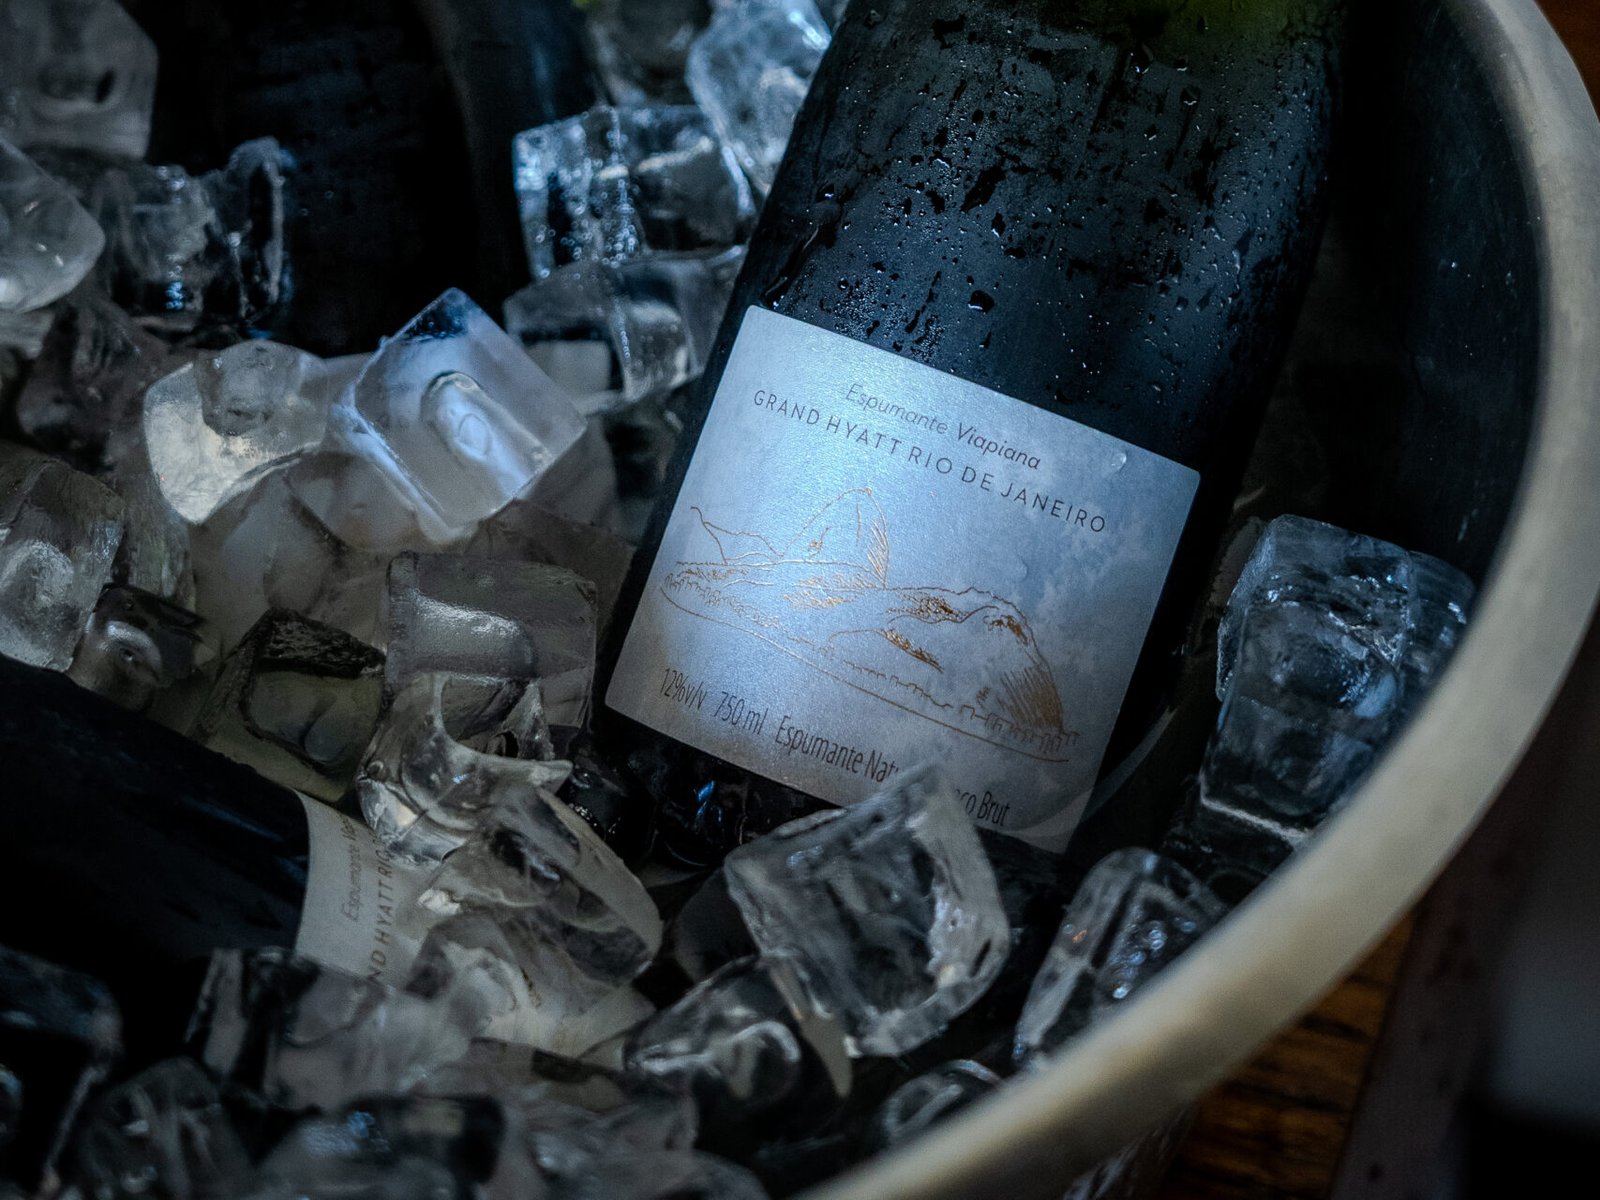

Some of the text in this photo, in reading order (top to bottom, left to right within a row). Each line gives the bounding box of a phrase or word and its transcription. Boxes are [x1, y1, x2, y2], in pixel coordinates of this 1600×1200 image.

[753, 390, 1106, 533] GRAND HYATT RIO DE JANEIRO
[845, 383, 1041, 470] Espumante Viapiana
[775, 714, 864, 774] Espumante
[864, 749, 899, 783] Nat
[977, 790, 1011, 827] Brut
[374, 881, 394, 945] HYATT
